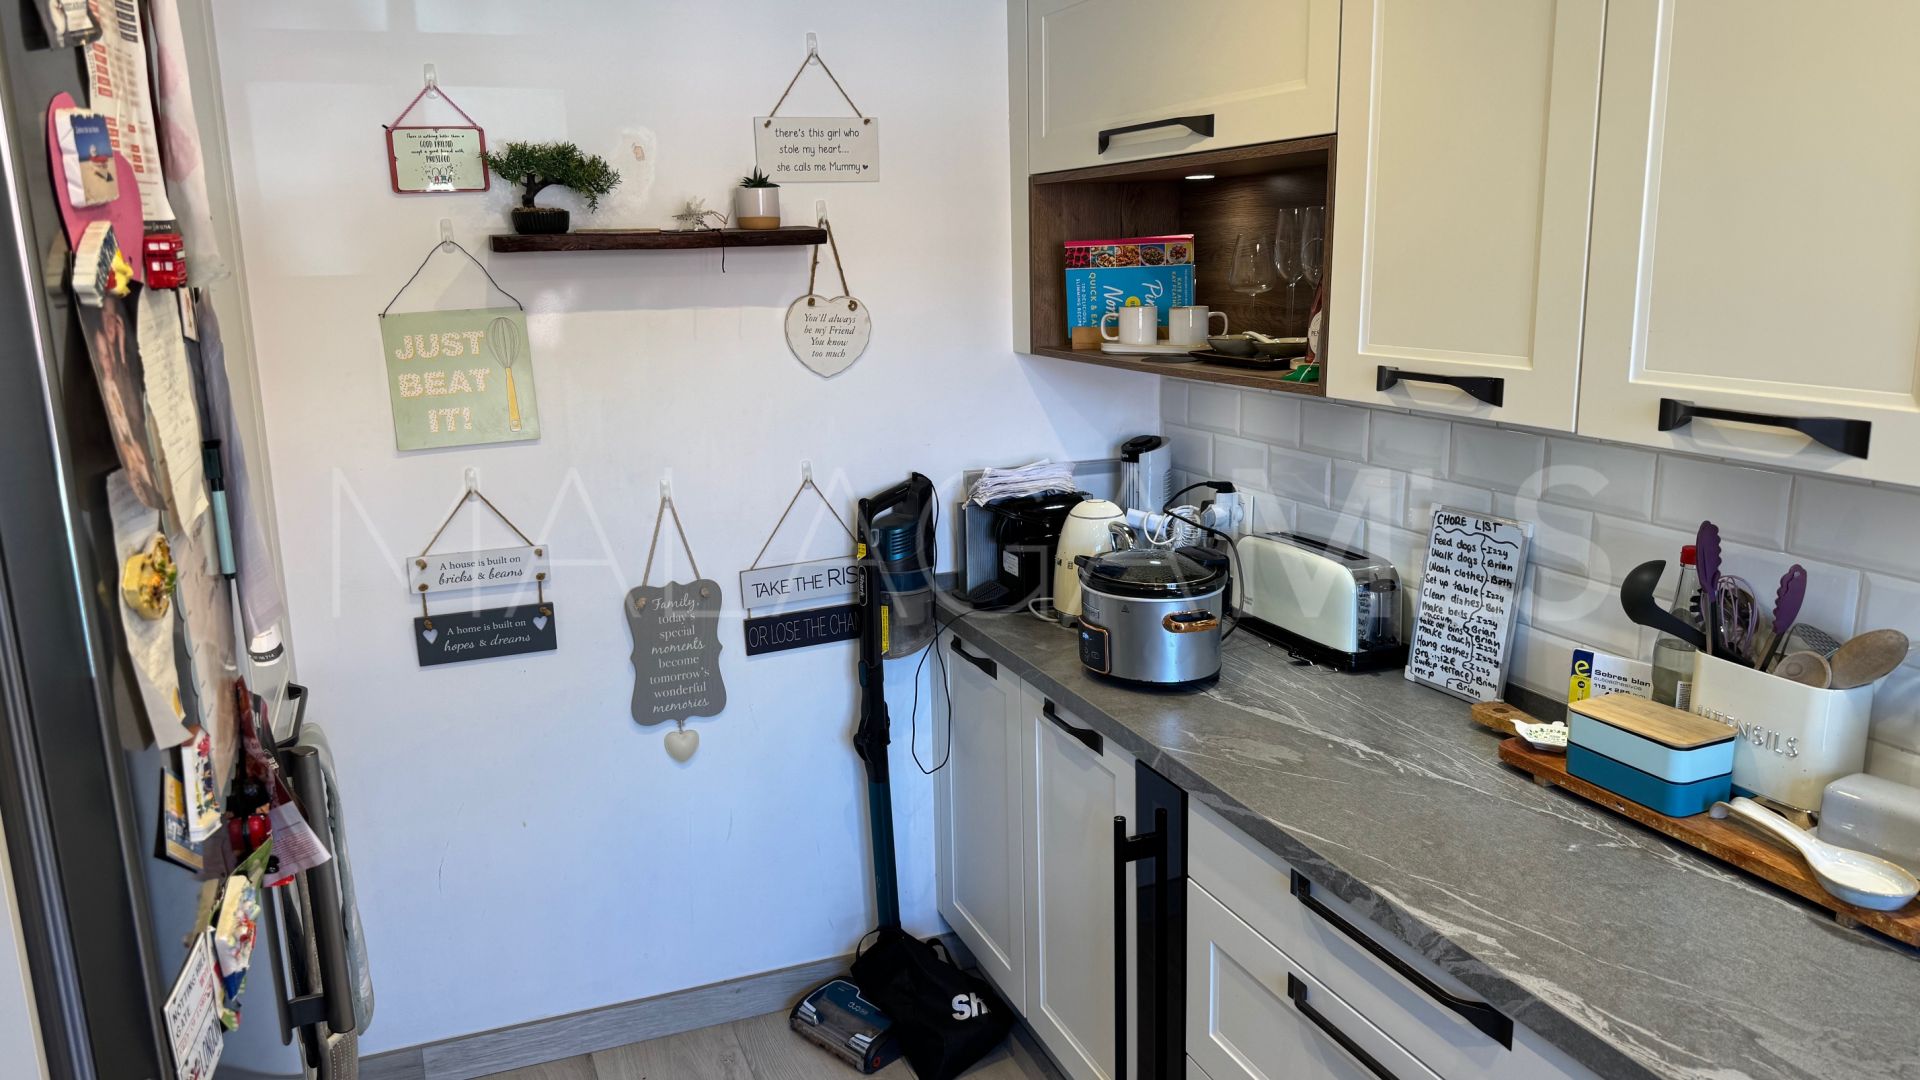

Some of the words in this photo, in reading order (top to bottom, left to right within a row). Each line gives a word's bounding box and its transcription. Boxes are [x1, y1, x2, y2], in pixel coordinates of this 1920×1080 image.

[775, 128, 805, 138] there's
[808, 128, 825, 138] this
[827, 128, 841, 141] girl
[843, 128, 860, 138] who
[779, 144, 800, 154] stole
[802, 146, 815, 157] my
[818, 144, 850, 154] heart...
[776, 162, 791, 172] she
[794, 162, 812, 172] calls
[814, 164, 827, 172] me
[829, 162, 861, 174] Mummy
[1088, 272, 1097, 302] QUICK
[804, 313, 827, 323] You'll
[828, 314, 856, 325] always
[804, 325, 812, 334] be
[814, 326, 827, 336] my
[828, 326, 856, 335] Friend
[395, 330, 485, 360] JUST
[811, 337, 824, 346] You
[826, 338, 848, 346] know
[812, 350, 823, 358] too
[825, 349, 846, 358] much
[398, 368, 490, 398] BEAT
[428, 407, 472, 433] IT!
[1437, 514, 1467, 527] CHORE
[1474, 520, 1502, 533] LIST
[1434, 533, 1452, 547] Feed
[1456, 540, 1476, 554] dogs
[1486, 546, 1508, 560] Izzy
[440, 563, 447, 571] A
[450, 560, 476, 569] house
[487, 556, 507, 566] built
[1431, 548, 1453, 561] Walk
[1457, 552, 1478, 568] dogs
[1487, 559, 1513, 572] Brian
[438, 571, 473, 585] bricks
[488, 568, 523, 580] beams
[752, 578, 791, 599] TAKE
[792, 574, 824, 592] THE
[828, 565, 860, 588] RIS
[1429, 561, 1450, 575] Wash
[1454, 568, 1484, 583] clothes
[1490, 575, 1512, 589] Both
[1426, 574, 1437, 584] Set
[1439, 580, 1449, 589] up
[1453, 581, 1479, 597] table
[1485, 590, 1504, 603] Izzy
[1424, 588, 1446, 600] Clean
[1451, 594, 1480, 608] dishes
[658, 610, 696, 625] today's
[1422, 601, 1443, 614] Make
[1476, 615, 1498, 630] Izzy
[447, 628, 454, 636] A
[456, 625, 482, 634] home
[484, 623, 490, 631] is
[492, 620, 513, 630] built
[659, 625, 696, 642] special
[748, 625, 769, 648] OR
[770, 620, 801, 645] LOSE
[802, 616, 827, 638] THE
[829, 611, 860, 635] CHAN
[1419, 625, 1442, 639] make
[1447, 633, 1470, 648] couch
[1420, 616, 1434, 627] take
[1448, 625, 1463, 635] bins
[1475, 635, 1500, 650] Brian
[1472, 625, 1496, 639] Brian
[443, 640, 475, 653] hopes
[490, 634, 531, 646] dreams
[651, 636, 706, 655] moments
[1417, 634, 1438, 651] Hang
[1440, 644, 1469, 659] clothes
[658, 656, 700, 669] become
[650, 667, 710, 685] tomorrow's
[1440, 664, 1470, 681] terrace
[1594, 669, 1628, 682] Sobres
[1631, 677, 1651, 687] blan
[654, 681, 707, 698] wonderful
[1456, 682, 1480, 698] Brian
[652, 697, 710, 714] memories
[952, 992, 989, 1021] Sh
